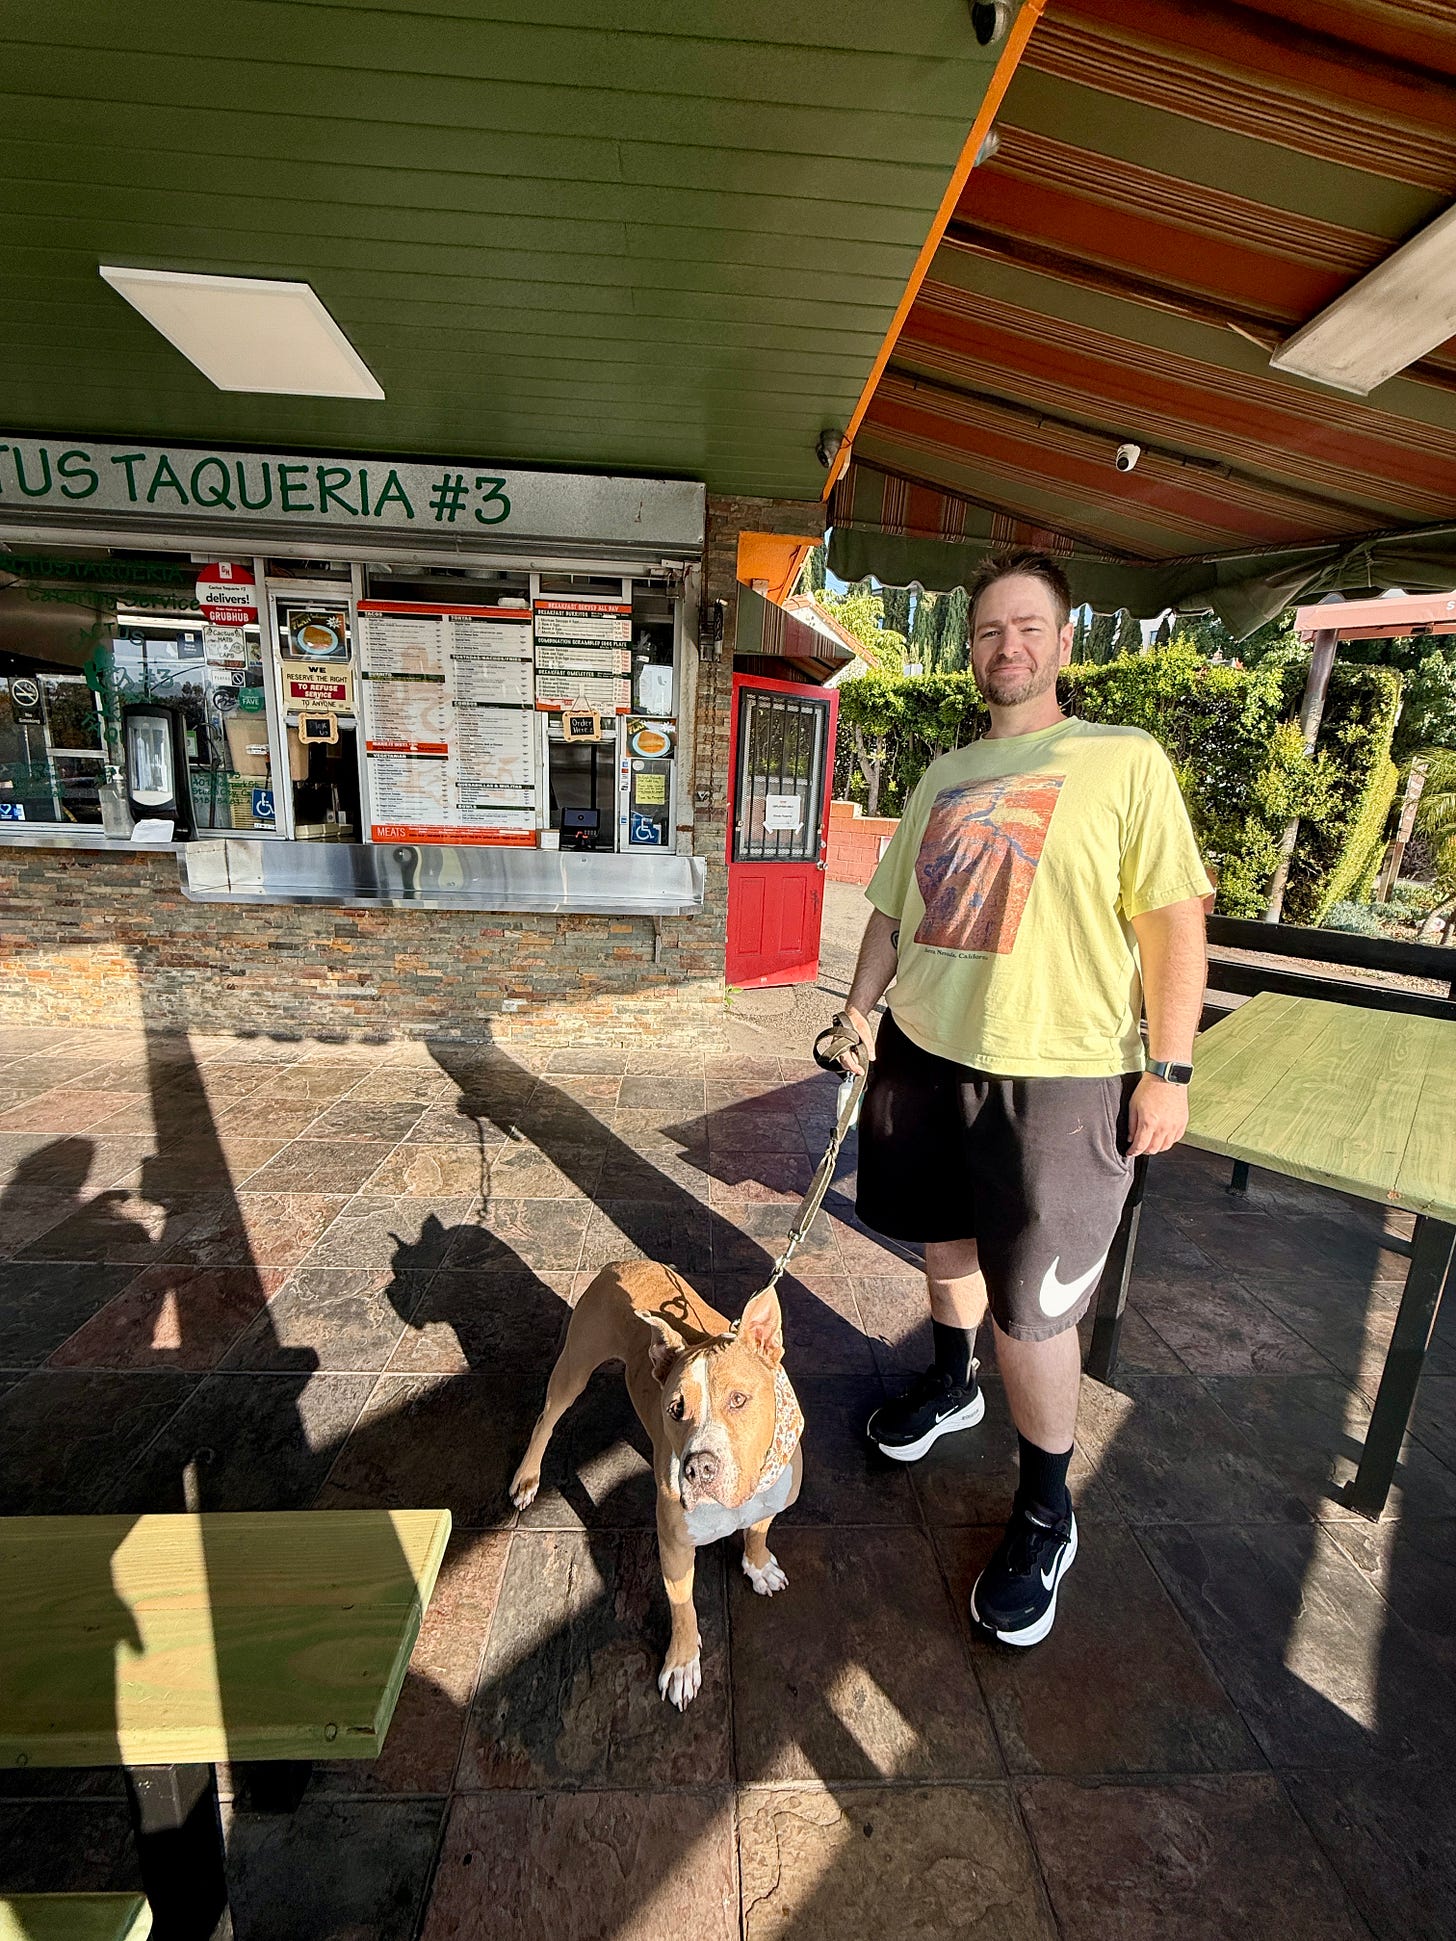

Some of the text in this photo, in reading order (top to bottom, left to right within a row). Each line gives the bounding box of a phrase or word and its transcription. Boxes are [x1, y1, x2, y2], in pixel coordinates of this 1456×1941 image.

[0, 445, 511, 525] US TAQUERIA #3
[122, 590, 199, 611] Service
[206, 593, 250, 605] delivers!
[547, 602, 577, 610] BREAKFAST
[209, 611, 249, 623] GRUBHUB
[571, 718, 593, 727] Order
[377, 827, 406, 837] MEATS
